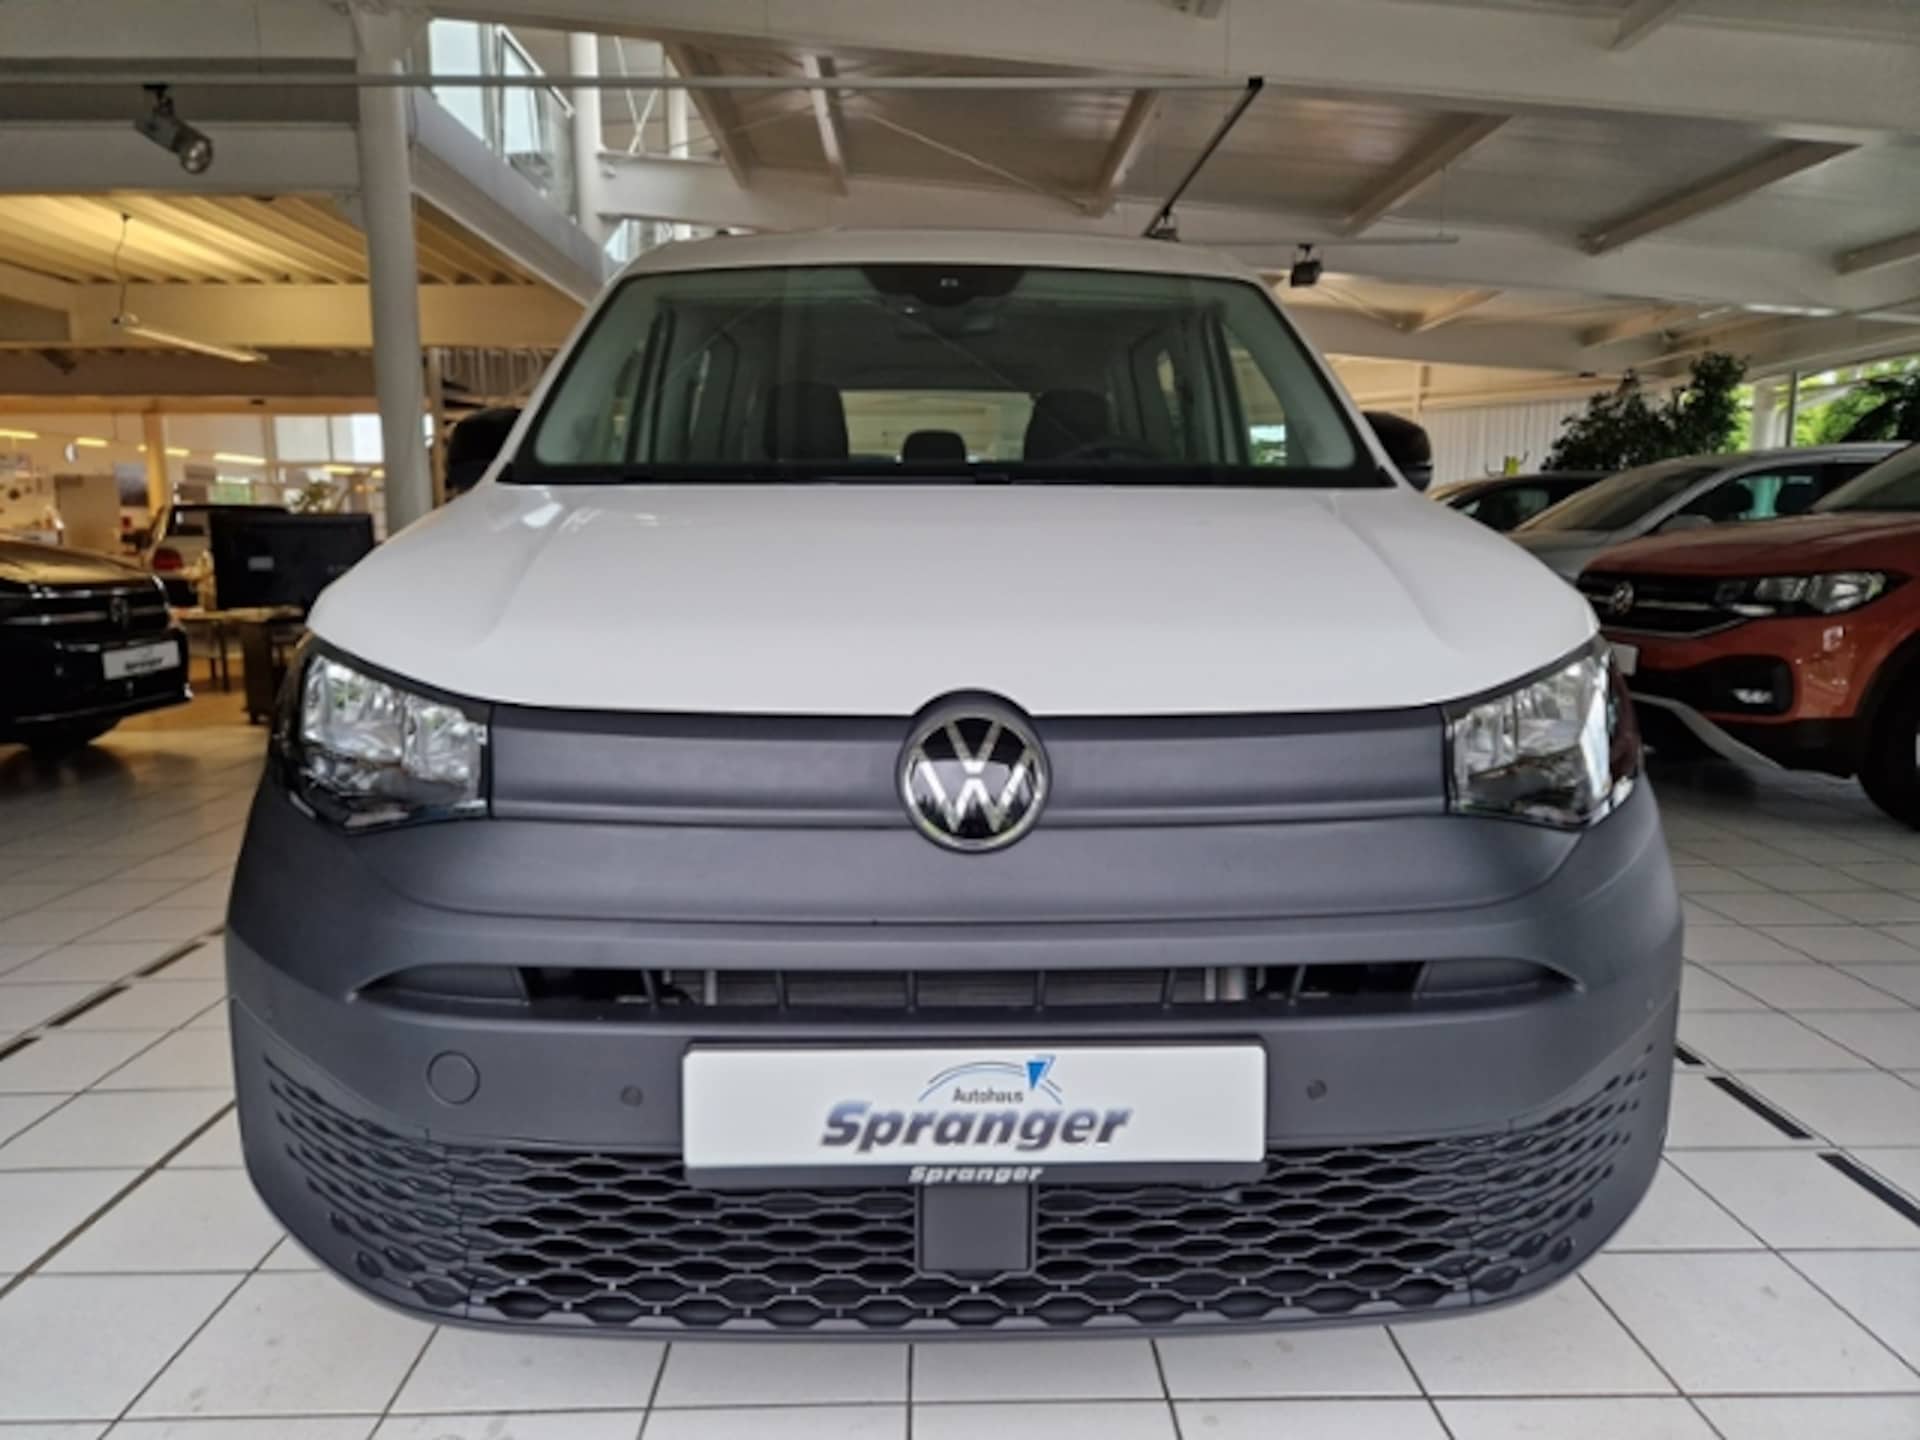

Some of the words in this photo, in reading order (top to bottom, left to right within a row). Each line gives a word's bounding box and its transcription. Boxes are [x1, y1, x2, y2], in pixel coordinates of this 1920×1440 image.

[952, 1087, 1024, 1104] Autohaus
[821, 1100, 1133, 1153] Spranger
[908, 1165, 1044, 1185] Spranger
